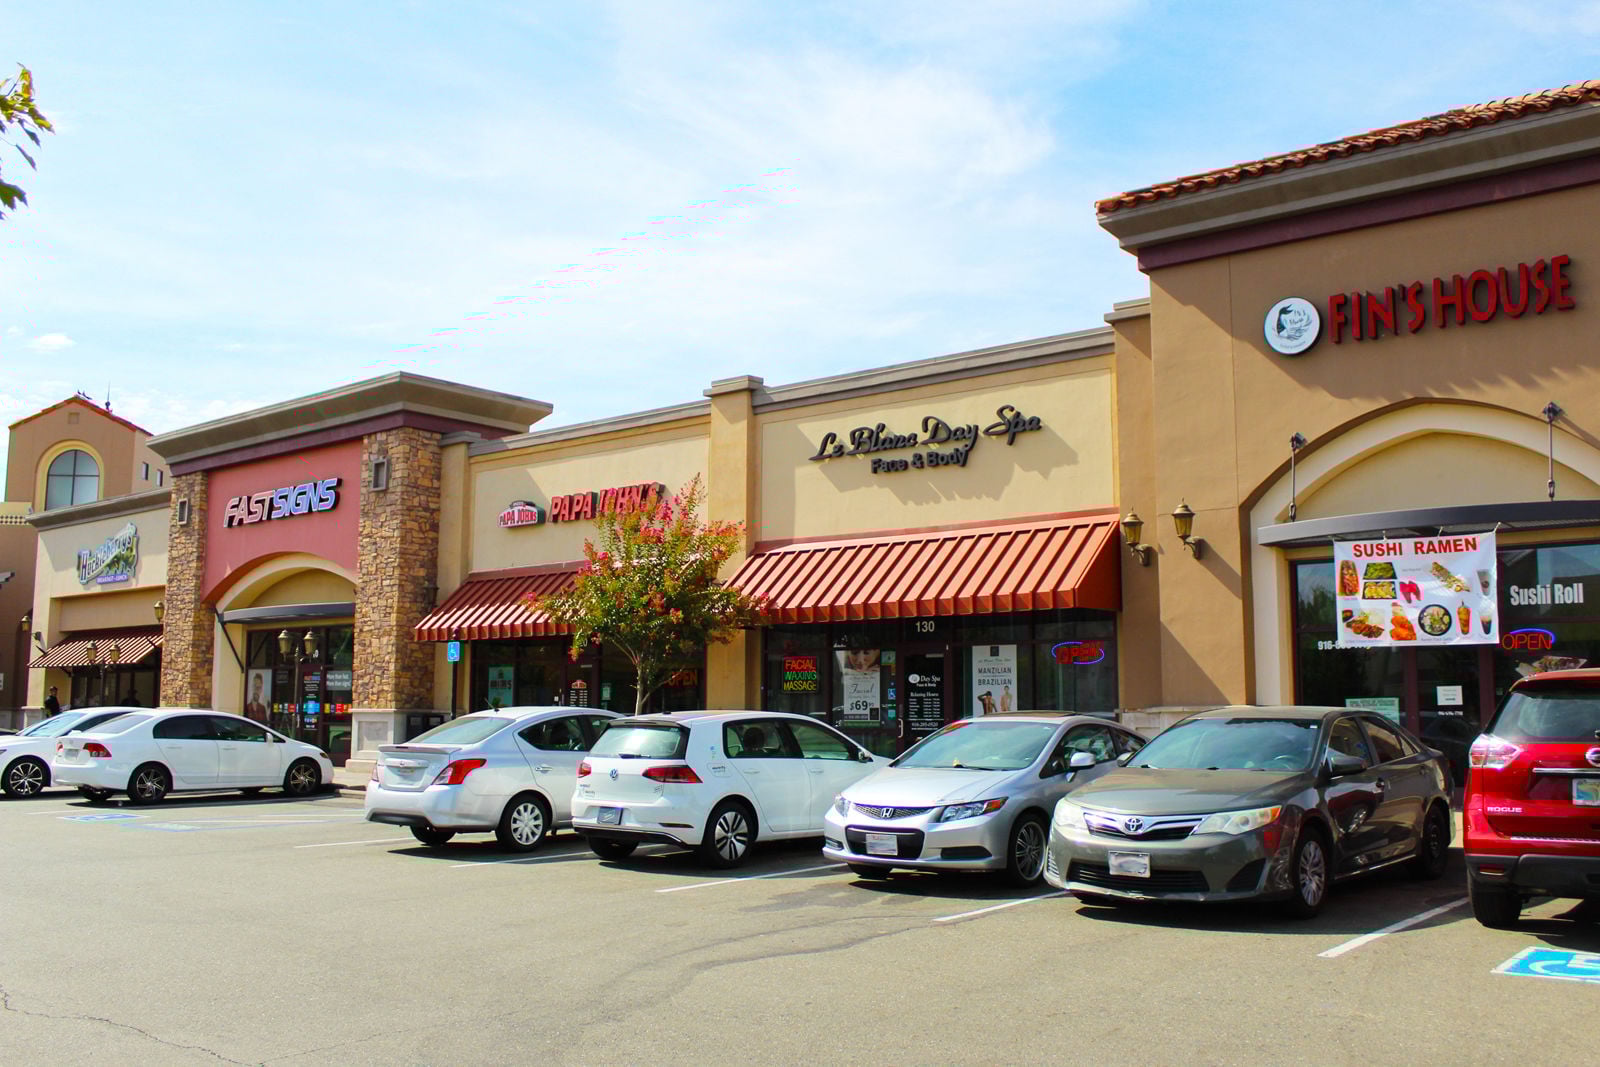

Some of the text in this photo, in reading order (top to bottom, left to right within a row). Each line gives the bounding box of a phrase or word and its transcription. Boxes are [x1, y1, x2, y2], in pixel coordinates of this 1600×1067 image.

[1328, 255, 1574, 344] FIN'S HOUSE
[808, 404, 1042, 461] Le Blanc Day Spa
[871, 447, 968, 474] Face & Body
[224, 478, 341, 528] FASTSIGNS
[551, 493, 596, 522] PAPA
[499, 510, 515, 526] PAPA
[1353, 537, 1478, 558] SUSHI RAMEN
[1510, 583, 1584, 606] Sushi Roll
[915, 621, 935, 632] 130
[1502, 634, 1552, 650] OPEN
[785, 659, 816, 670] FACIAL
[978, 666, 1012, 675] MANZILIAN
[784, 670, 817, 681] WAXING
[978, 678, 1012, 687] BRAZILIAN
[784, 681, 817, 691] MASSAGE
